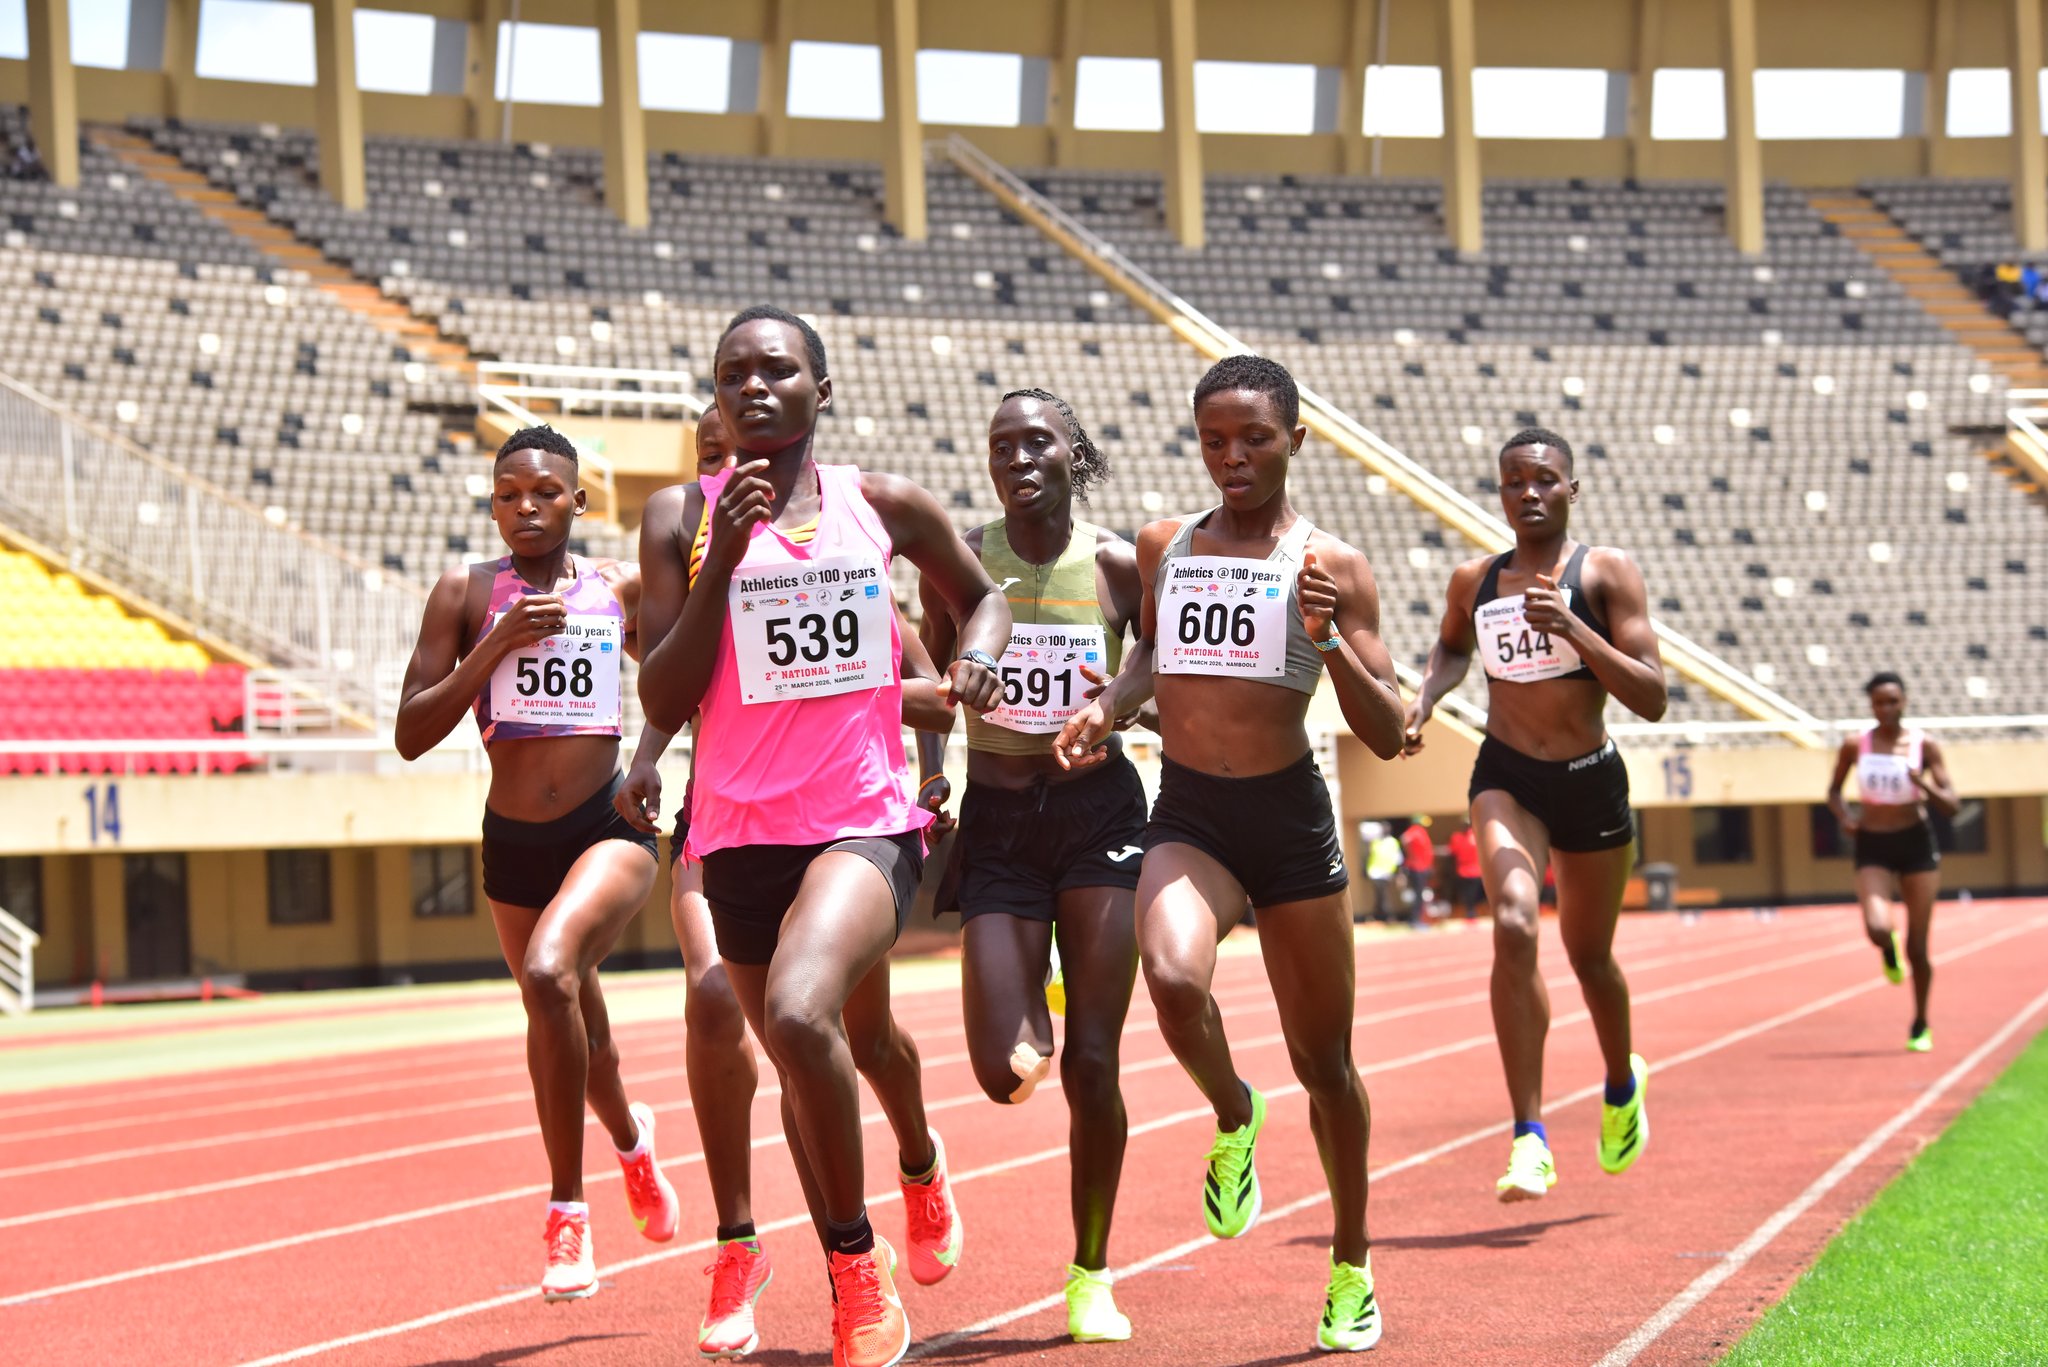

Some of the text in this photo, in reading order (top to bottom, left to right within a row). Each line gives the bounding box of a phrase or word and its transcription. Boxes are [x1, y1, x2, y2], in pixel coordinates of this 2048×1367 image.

[740, 576, 798, 593] Athletics
[844, 567, 876, 583] years
[1173, 566, 1213, 579] Athletics
[1251, 571, 1281, 582] years
[585, 628, 612, 638] years
[1178, 602, 1255, 646] 606
[766, 609, 859, 666] 539
[1008, 634, 1032, 645] etics
[1069, 638, 1096, 648] years
[1497, 629, 1553, 663] 544
[1184, 648, 1223, 657] NATIONAL
[1229, 650, 1260, 659] TRIALS
[516, 657, 593, 698] 568
[782, 666, 830, 680] NATIONAL
[836, 660, 867, 673] TRIALS
[834, 674, 865, 684] NAMBOOLE
[1002, 667, 1071, 707] 591
[524, 700, 563, 708] NATIONAL
[1008, 709, 1047, 717] NATIONAL
[1052, 709, 1078, 717] TRIALS
[1568, 753, 1598, 772] NIKE
[1662, 755, 1692, 796] 15
[84, 784, 121, 841] 14
